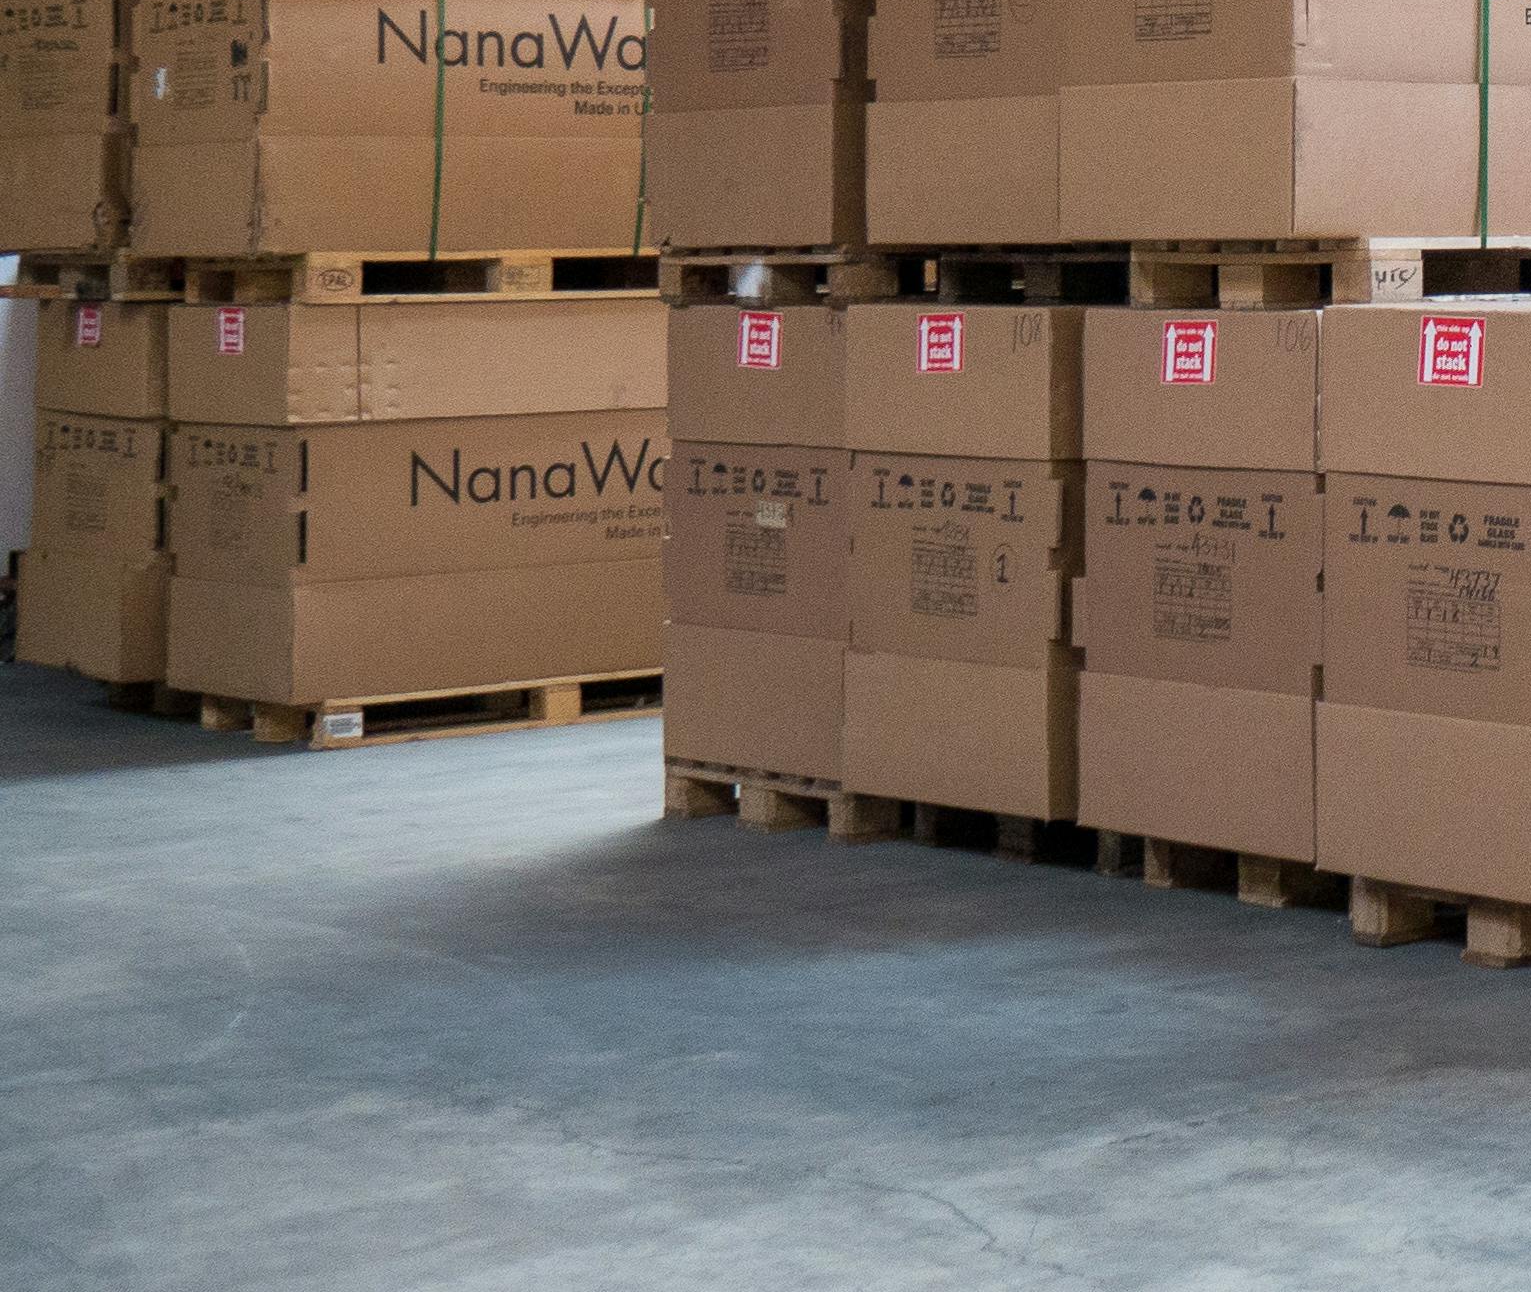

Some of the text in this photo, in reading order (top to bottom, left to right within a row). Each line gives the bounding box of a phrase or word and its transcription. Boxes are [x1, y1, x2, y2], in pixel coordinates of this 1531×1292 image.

[378, 8, 648, 71] NanaWa
[480, 79, 567, 97] Engineering
[575, 100, 613, 115] Made
[1437, 337, 1467, 352] do not
[1436, 353, 1466, 371] stack
[411, 439, 664, 507] NanaW
